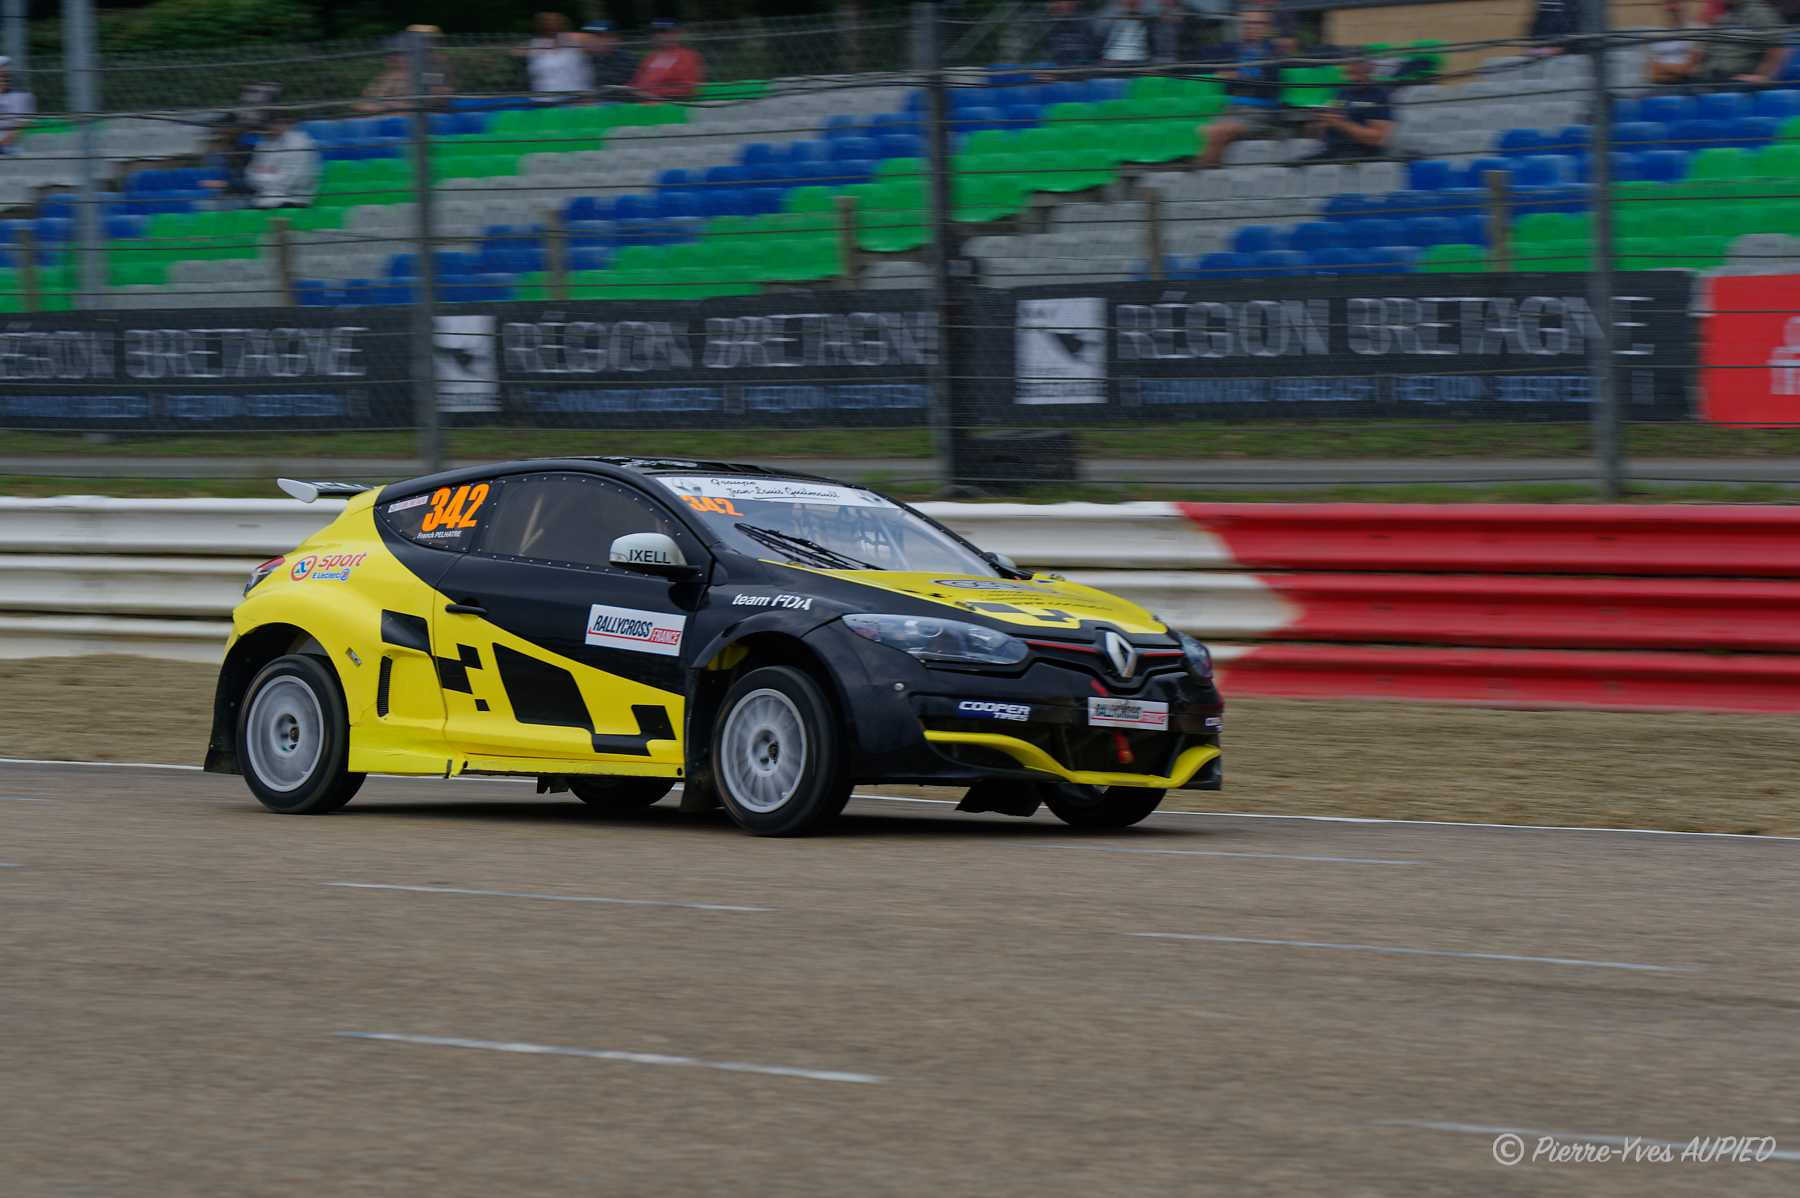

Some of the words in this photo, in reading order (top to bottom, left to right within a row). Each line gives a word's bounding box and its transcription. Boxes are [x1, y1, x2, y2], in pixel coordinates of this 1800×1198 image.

[1116, 290, 1330, 359] RÉGION
[420, 483, 491, 532] 342
[680, 494, 745, 518] 342
[318, 552, 368, 571] sport
[629, 548, 672, 564] IXELL
[732, 592, 770, 606] team
[593, 615, 654, 638] RALLYCROSS
[959, 700, 1032, 716] COOPER
